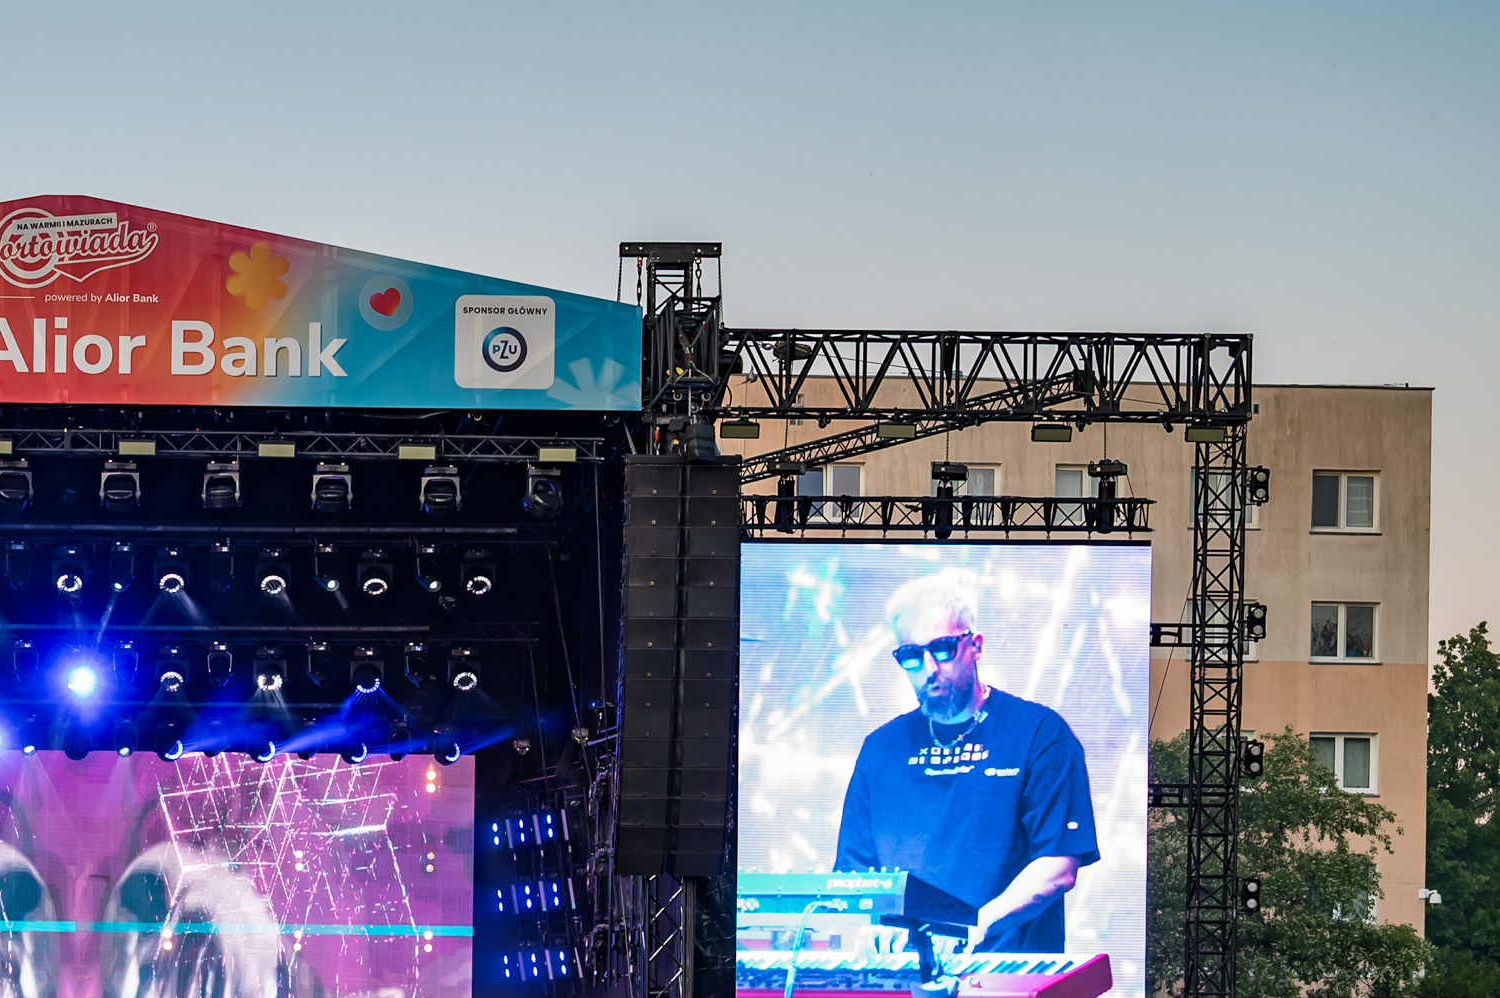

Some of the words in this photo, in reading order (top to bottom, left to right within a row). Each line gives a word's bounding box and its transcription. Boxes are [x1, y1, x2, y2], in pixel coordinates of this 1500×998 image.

[66, 217, 113, 227] MAZURACH
[45, 293, 88, 303] powered
[90, 293, 103, 304] by
[104, 293, 131, 303] Alior
[133, 294, 159, 303] Bank
[463, 306, 505, 315] SPONSOR
[507, 306, 548, 315] GŁÓWNY
[171, 320, 348, 377] Bank
[492, 339, 518, 360] PZU
